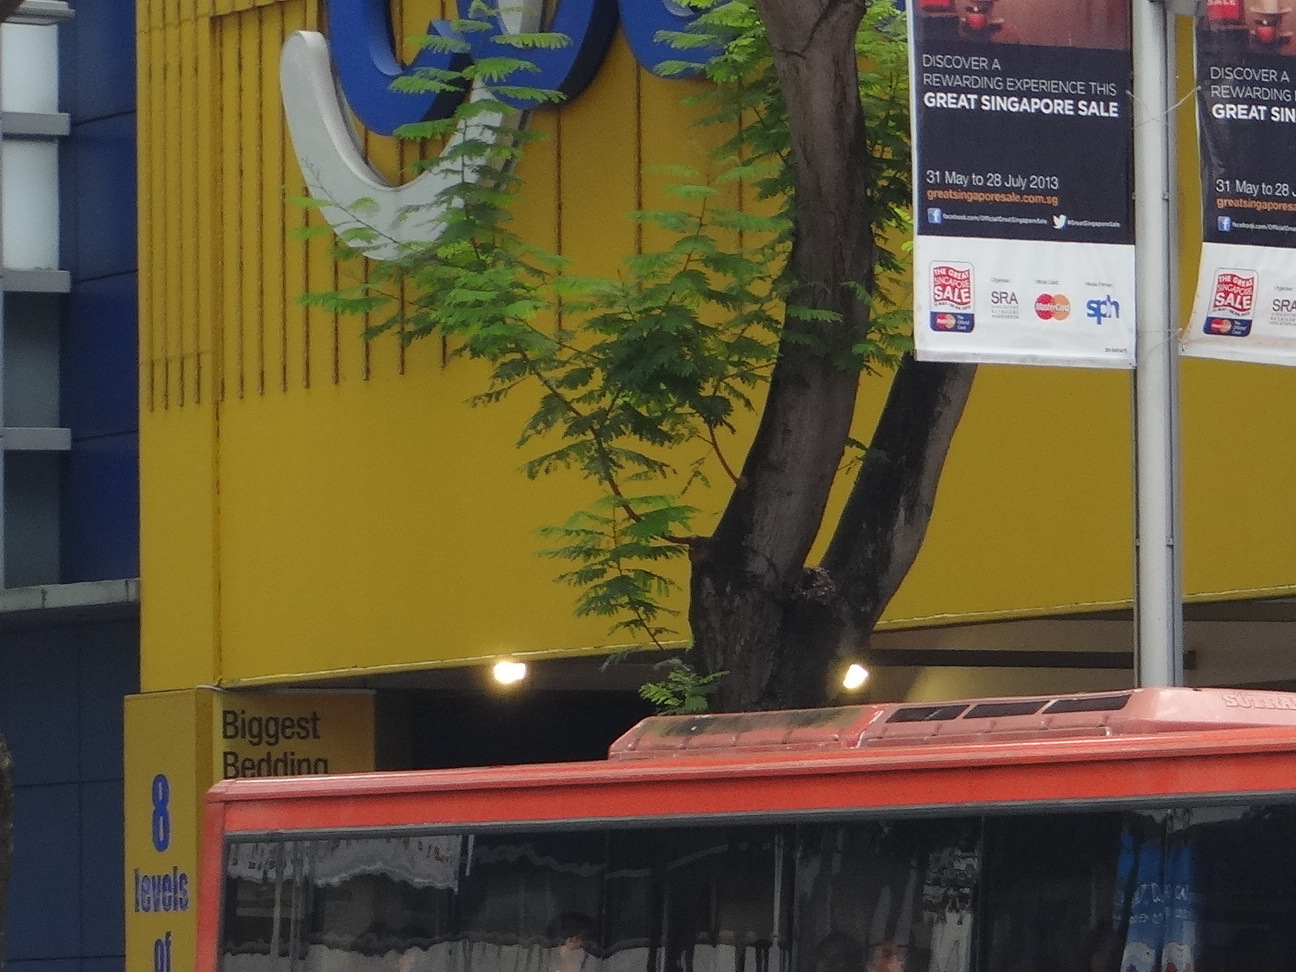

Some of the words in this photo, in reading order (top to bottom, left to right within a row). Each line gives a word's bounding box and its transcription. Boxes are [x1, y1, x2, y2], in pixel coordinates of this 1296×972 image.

[922, 54, 988, 70] DISCOVER
[991, 58, 1001, 71] A
[1210, 66, 1278, 82] DISCOVER
[1280, 71, 1290, 83] A
[923, 73, 1003, 91] REWARDING
[1006, 78, 1085, 95] EXPERIENCE
[1089, 82, 1117, 97] THIS
[1211, 85, 1292, 102] REWARDING
[923, 92, 978, 110] GREAT
[980, 95, 1075, 116] SINGAPORE
[1077, 100, 1119, 118] SALE
[1211, 103, 1267, 121] GREAT
[926, 170, 940, 184] 31
[944, 170, 968, 188] May
[972, 173, 984, 187] to
[986, 173, 1001, 187] 28
[1004, 174, 1027, 190] July
[1029, 176, 1059, 190] 2013
[1216, 179, 1231, 193] 31
[1236, 180, 1258, 196] May
[1261, 182, 1273, 195] to
[1275, 183, 1289, 197] 28
[926, 188, 1059, 207] greatsingaporesale.com.sg
[934, 268, 946, 276] THE
[948, 269, 970, 280] GREAT
[1218, 275, 1231, 283] THE
[1232, 276, 1253, 287] GREAT
[934, 286, 970, 303] SALE
[991, 290, 1019, 305] SRA
[1215, 292, 1252, 309] SALE
[222, 709, 321, 747] Biggest
[151, 773, 171, 852] 8
[134, 866, 189, 913] levels
